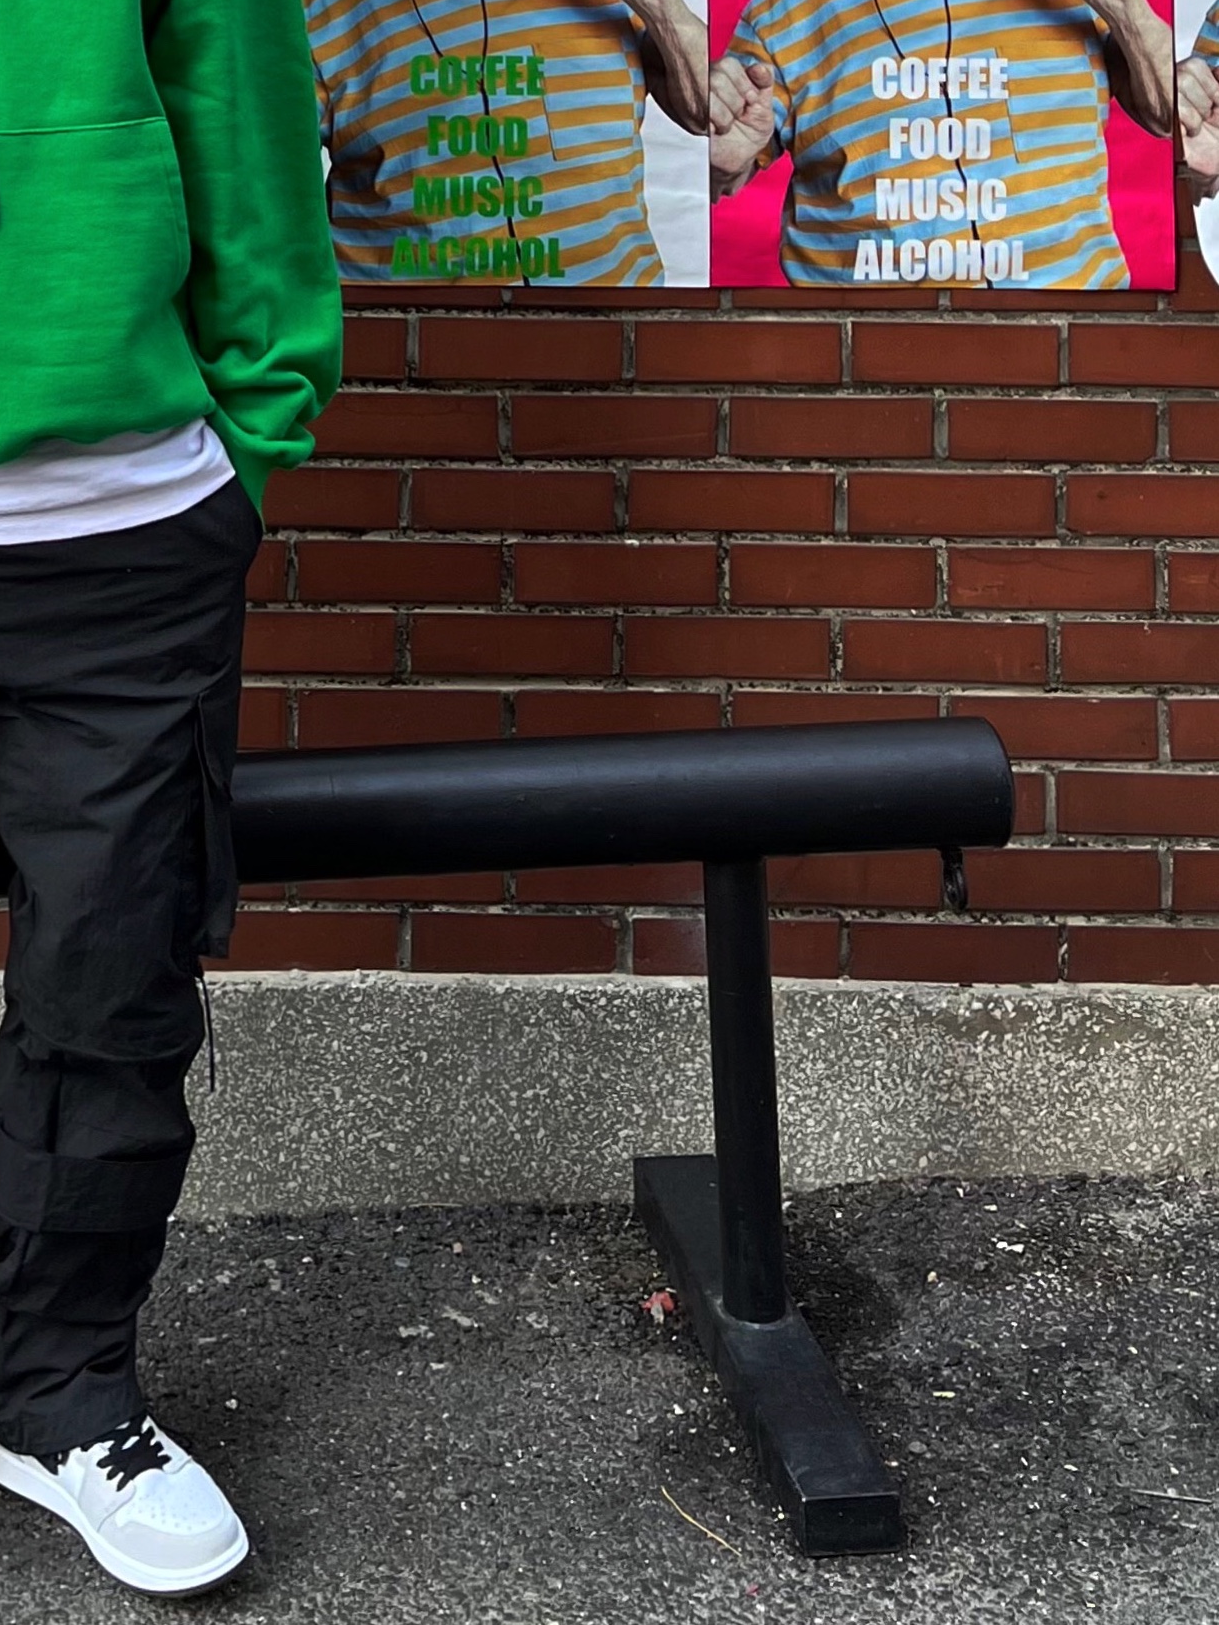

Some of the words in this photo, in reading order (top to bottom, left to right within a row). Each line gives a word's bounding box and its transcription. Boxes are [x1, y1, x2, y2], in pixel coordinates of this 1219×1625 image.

[408, 55, 546, 98] COFFEE
[870, 56, 1009, 101] COFFEE
[426, 116, 528, 158] FOOD
[888, 117, 992, 161] FOOD
[411, 176, 544, 219] MUSIC
[875, 177, 1007, 222] MUSIC
[389, 236, 565, 280] ALCOHOL
[853, 238, 1029, 283] ALCOHOL
